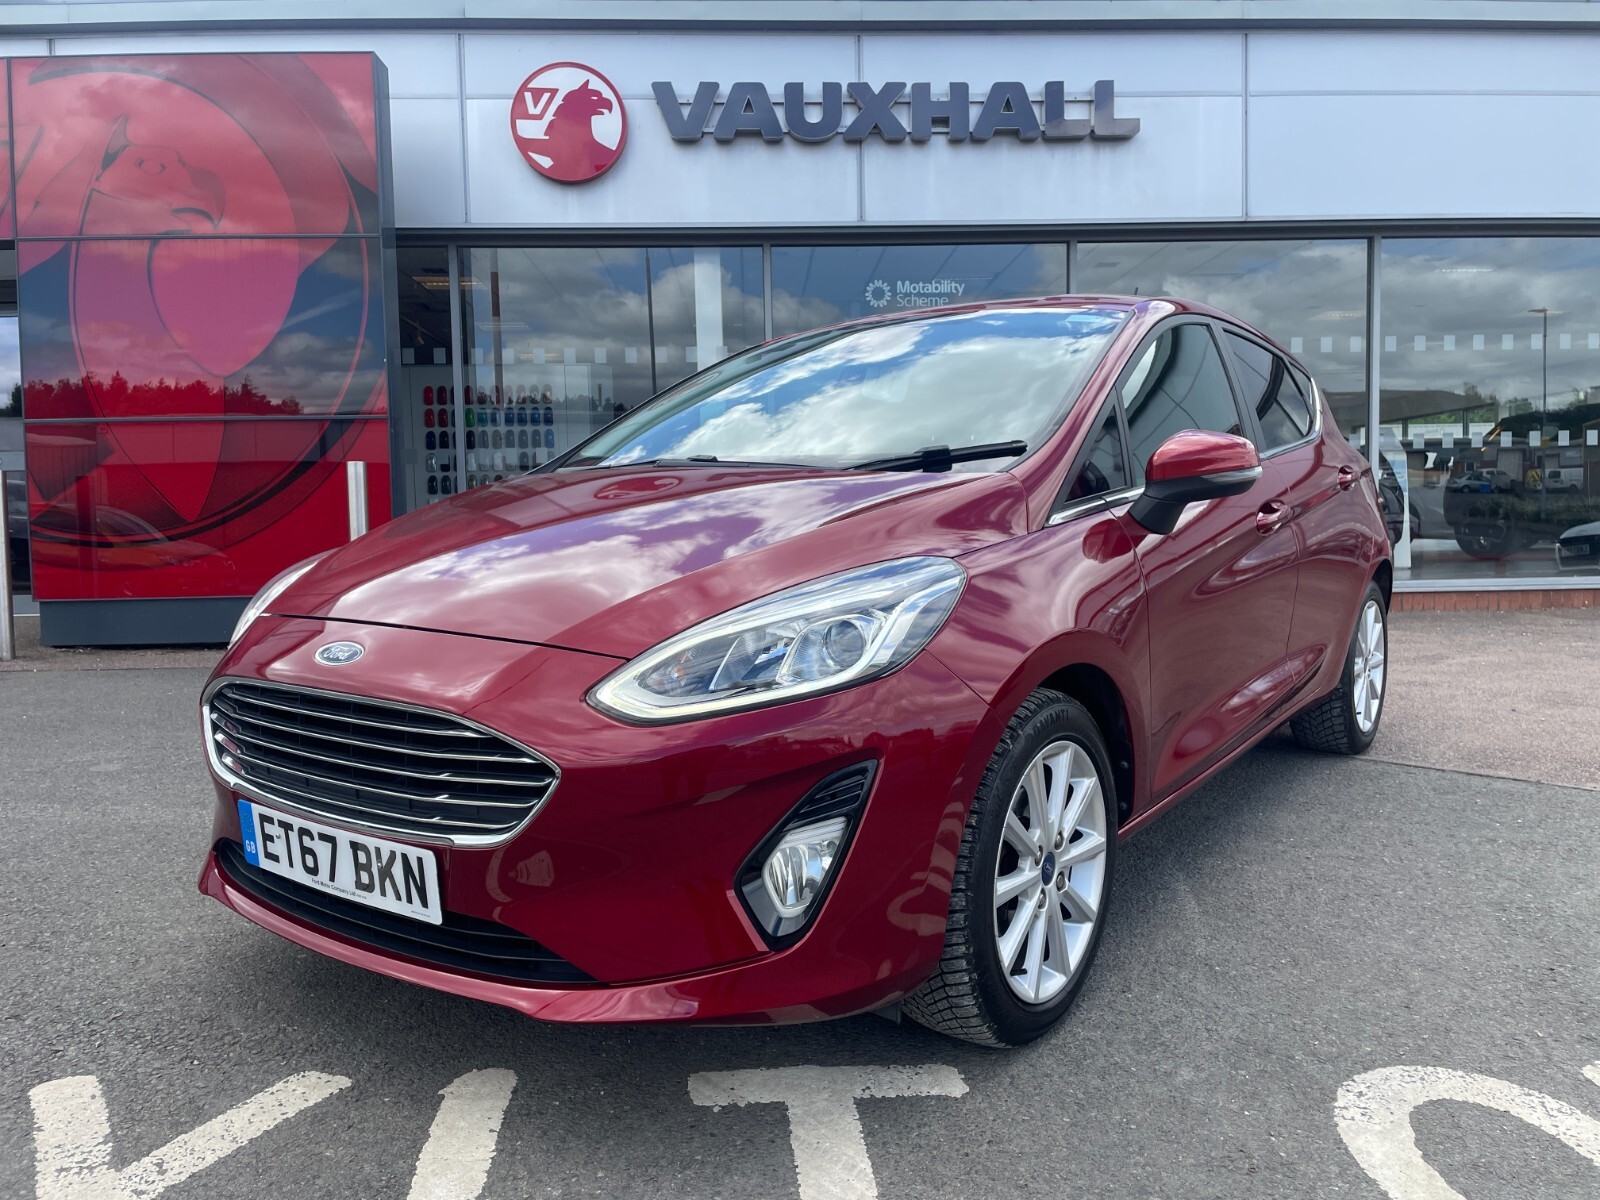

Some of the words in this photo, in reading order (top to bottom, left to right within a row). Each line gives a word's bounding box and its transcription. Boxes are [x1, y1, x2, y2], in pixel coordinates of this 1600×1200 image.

[651, 79, 1141, 143] VAUXHALL
[896, 280, 965, 296] Motability
[896, 294, 949, 306] Scheme
[323, 645, 353, 660] Ford
[245, 839, 256, 853] GB
[258, 812, 338, 883] ET67
[349, 839, 429, 909] BKN
